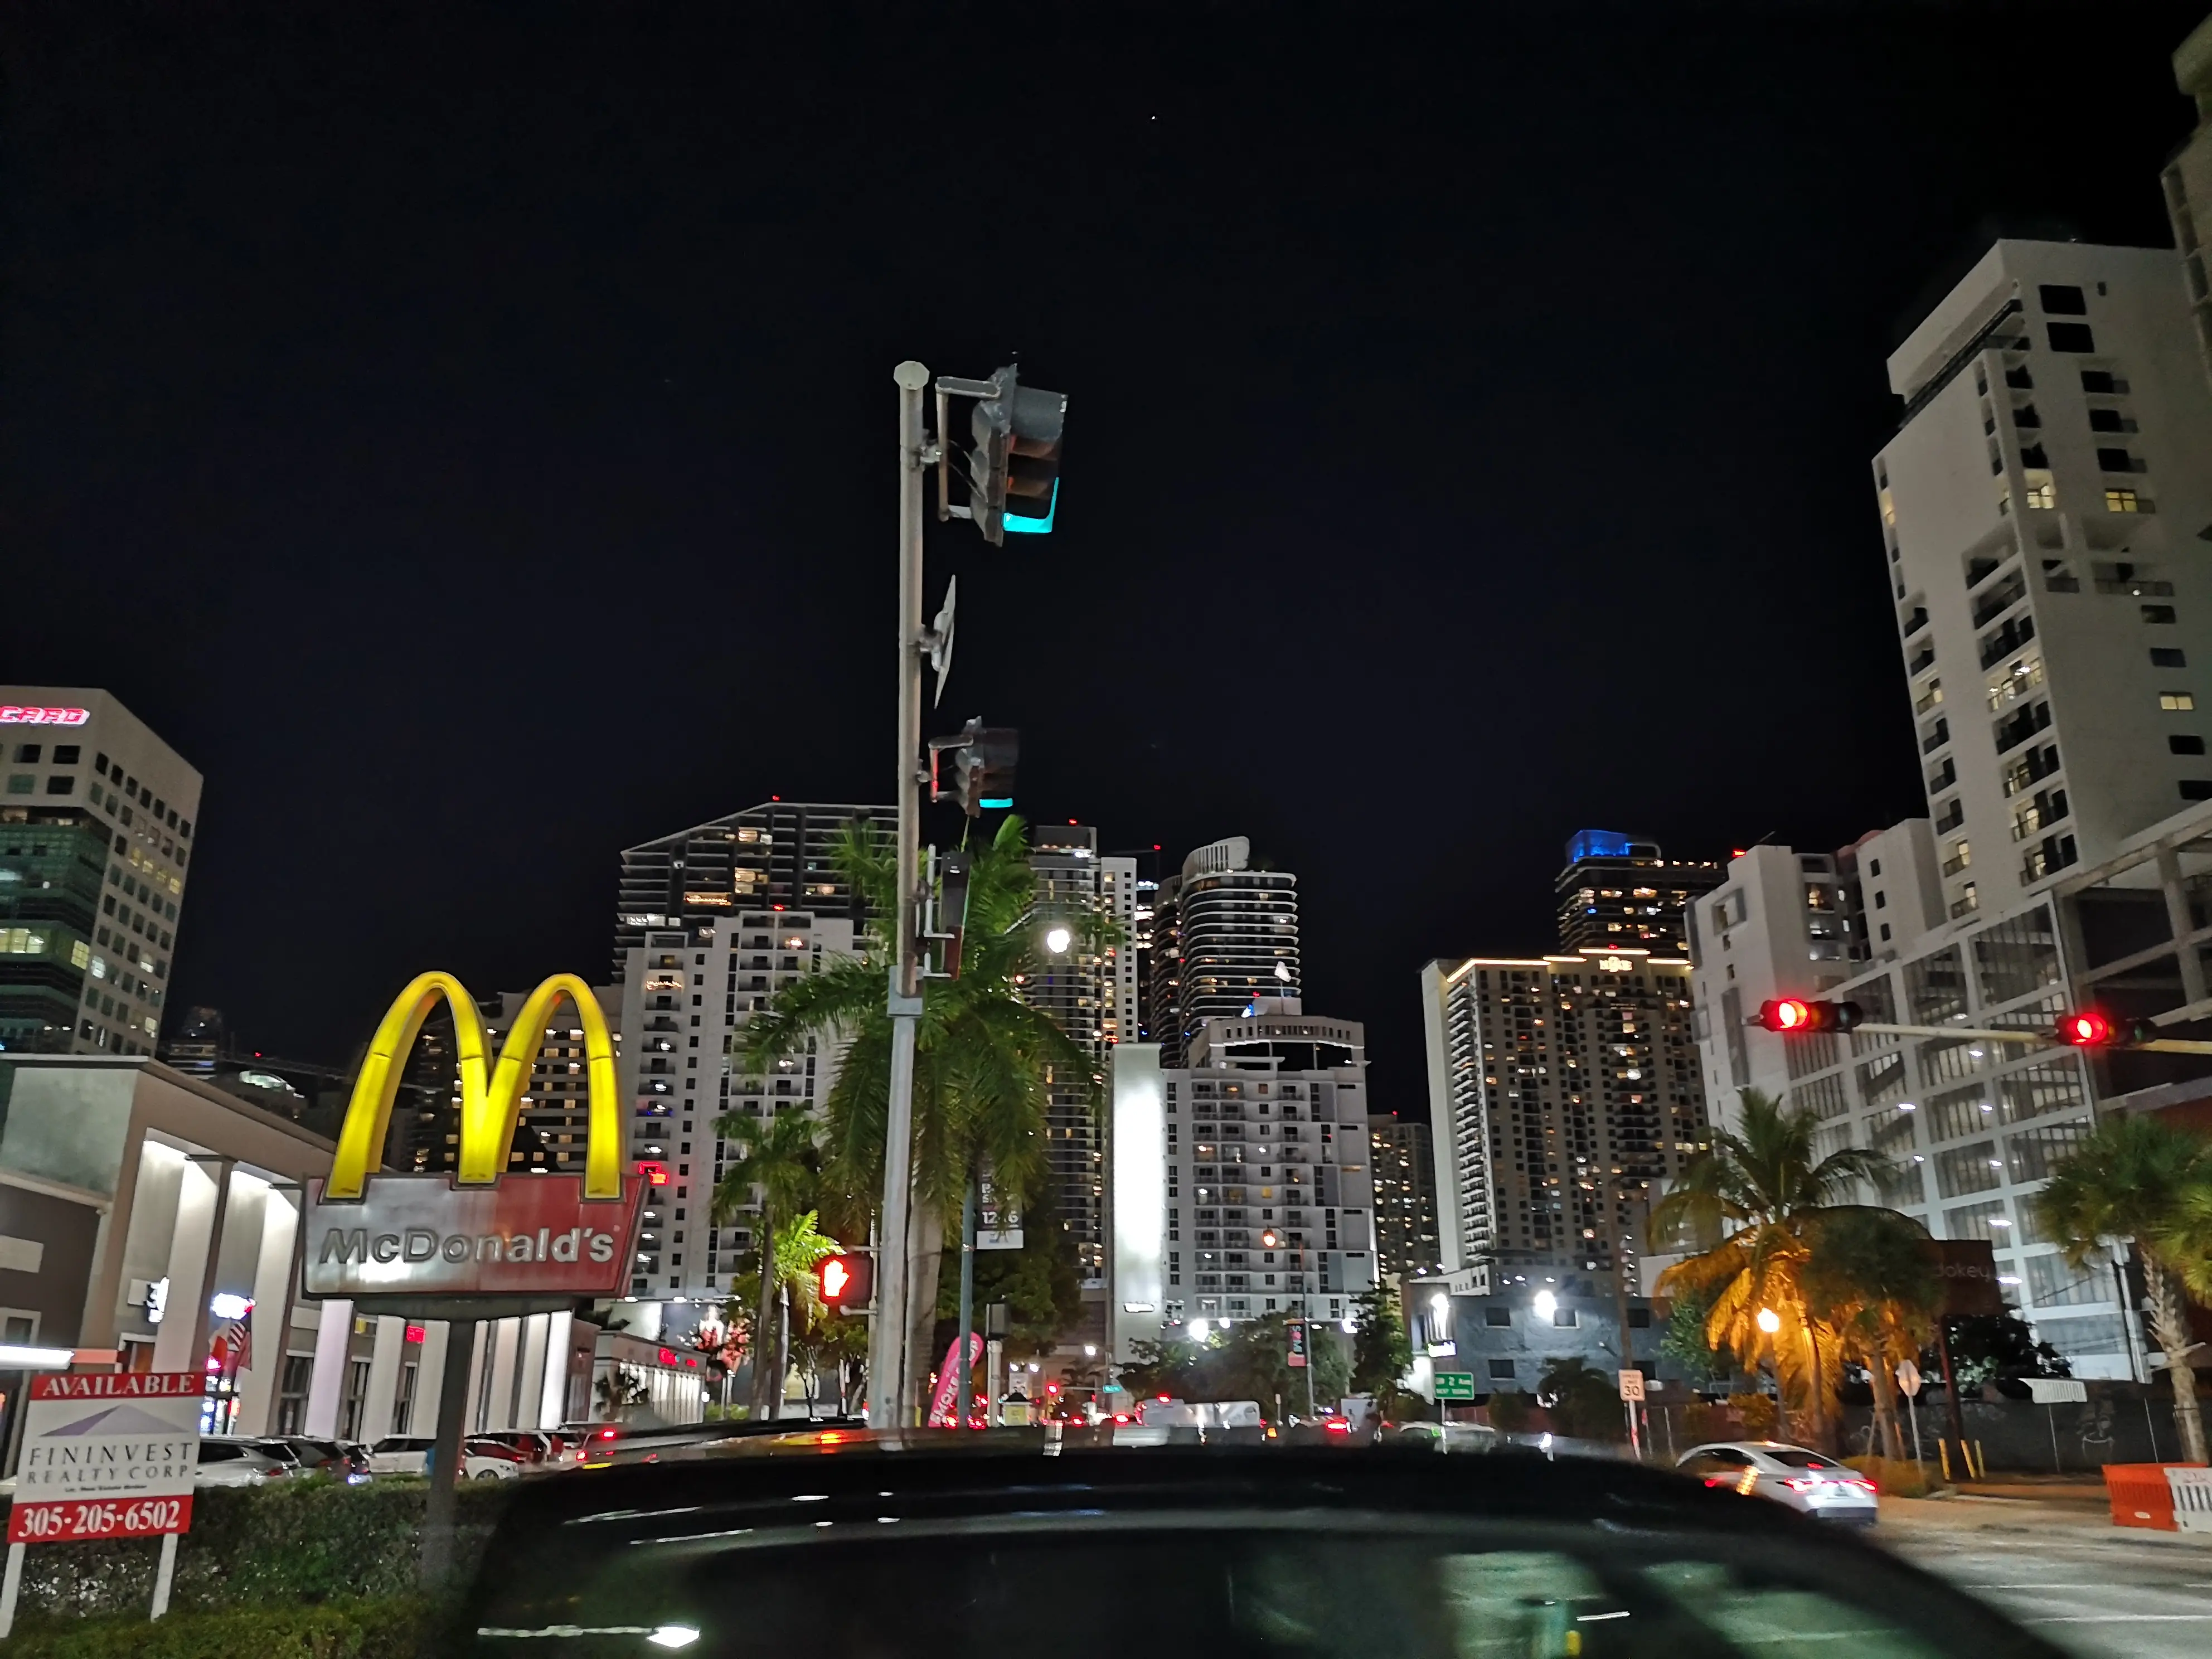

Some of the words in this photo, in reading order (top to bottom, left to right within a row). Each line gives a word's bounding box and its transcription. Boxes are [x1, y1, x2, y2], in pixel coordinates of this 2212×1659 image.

[319, 1228, 614, 1264] McDonald's
[42, 1374, 195, 1396] AVAILABLE
[1624, 1385, 1639, 1396] 30
[30, 1443, 193, 1466] FININVEST
[28, 1468, 118, 1484] REALTY
[129, 1465, 188, 1480] CORP
